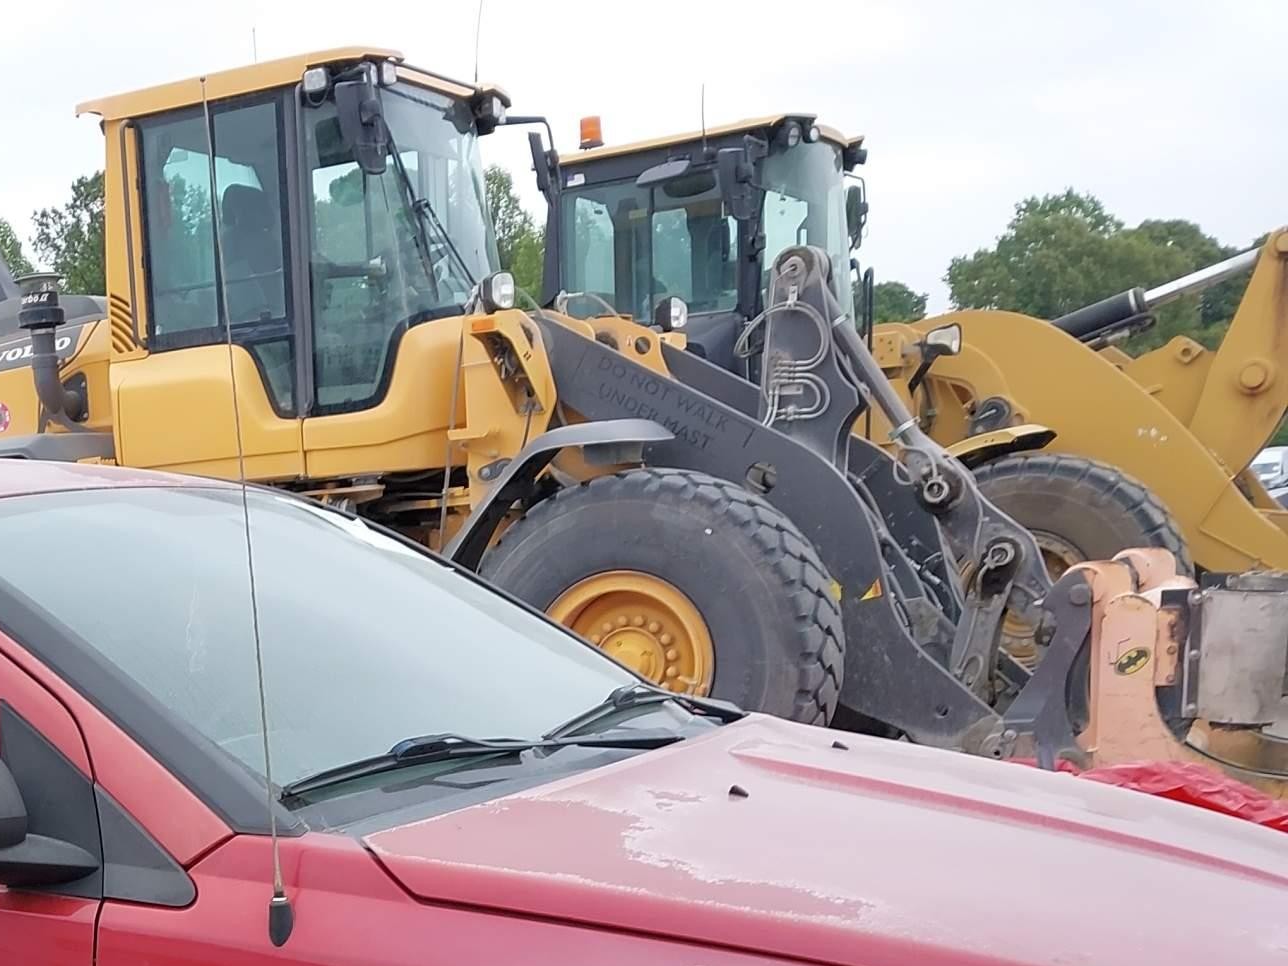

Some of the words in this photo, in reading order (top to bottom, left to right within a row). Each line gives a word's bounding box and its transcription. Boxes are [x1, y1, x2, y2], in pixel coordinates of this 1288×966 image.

[598, 355, 626, 379] DO
[631, 375, 671, 401] NOT
[677, 393, 729, 433] WALK
[599, 382, 658, 420] UNDER
[663, 415, 715, 449] MAST
